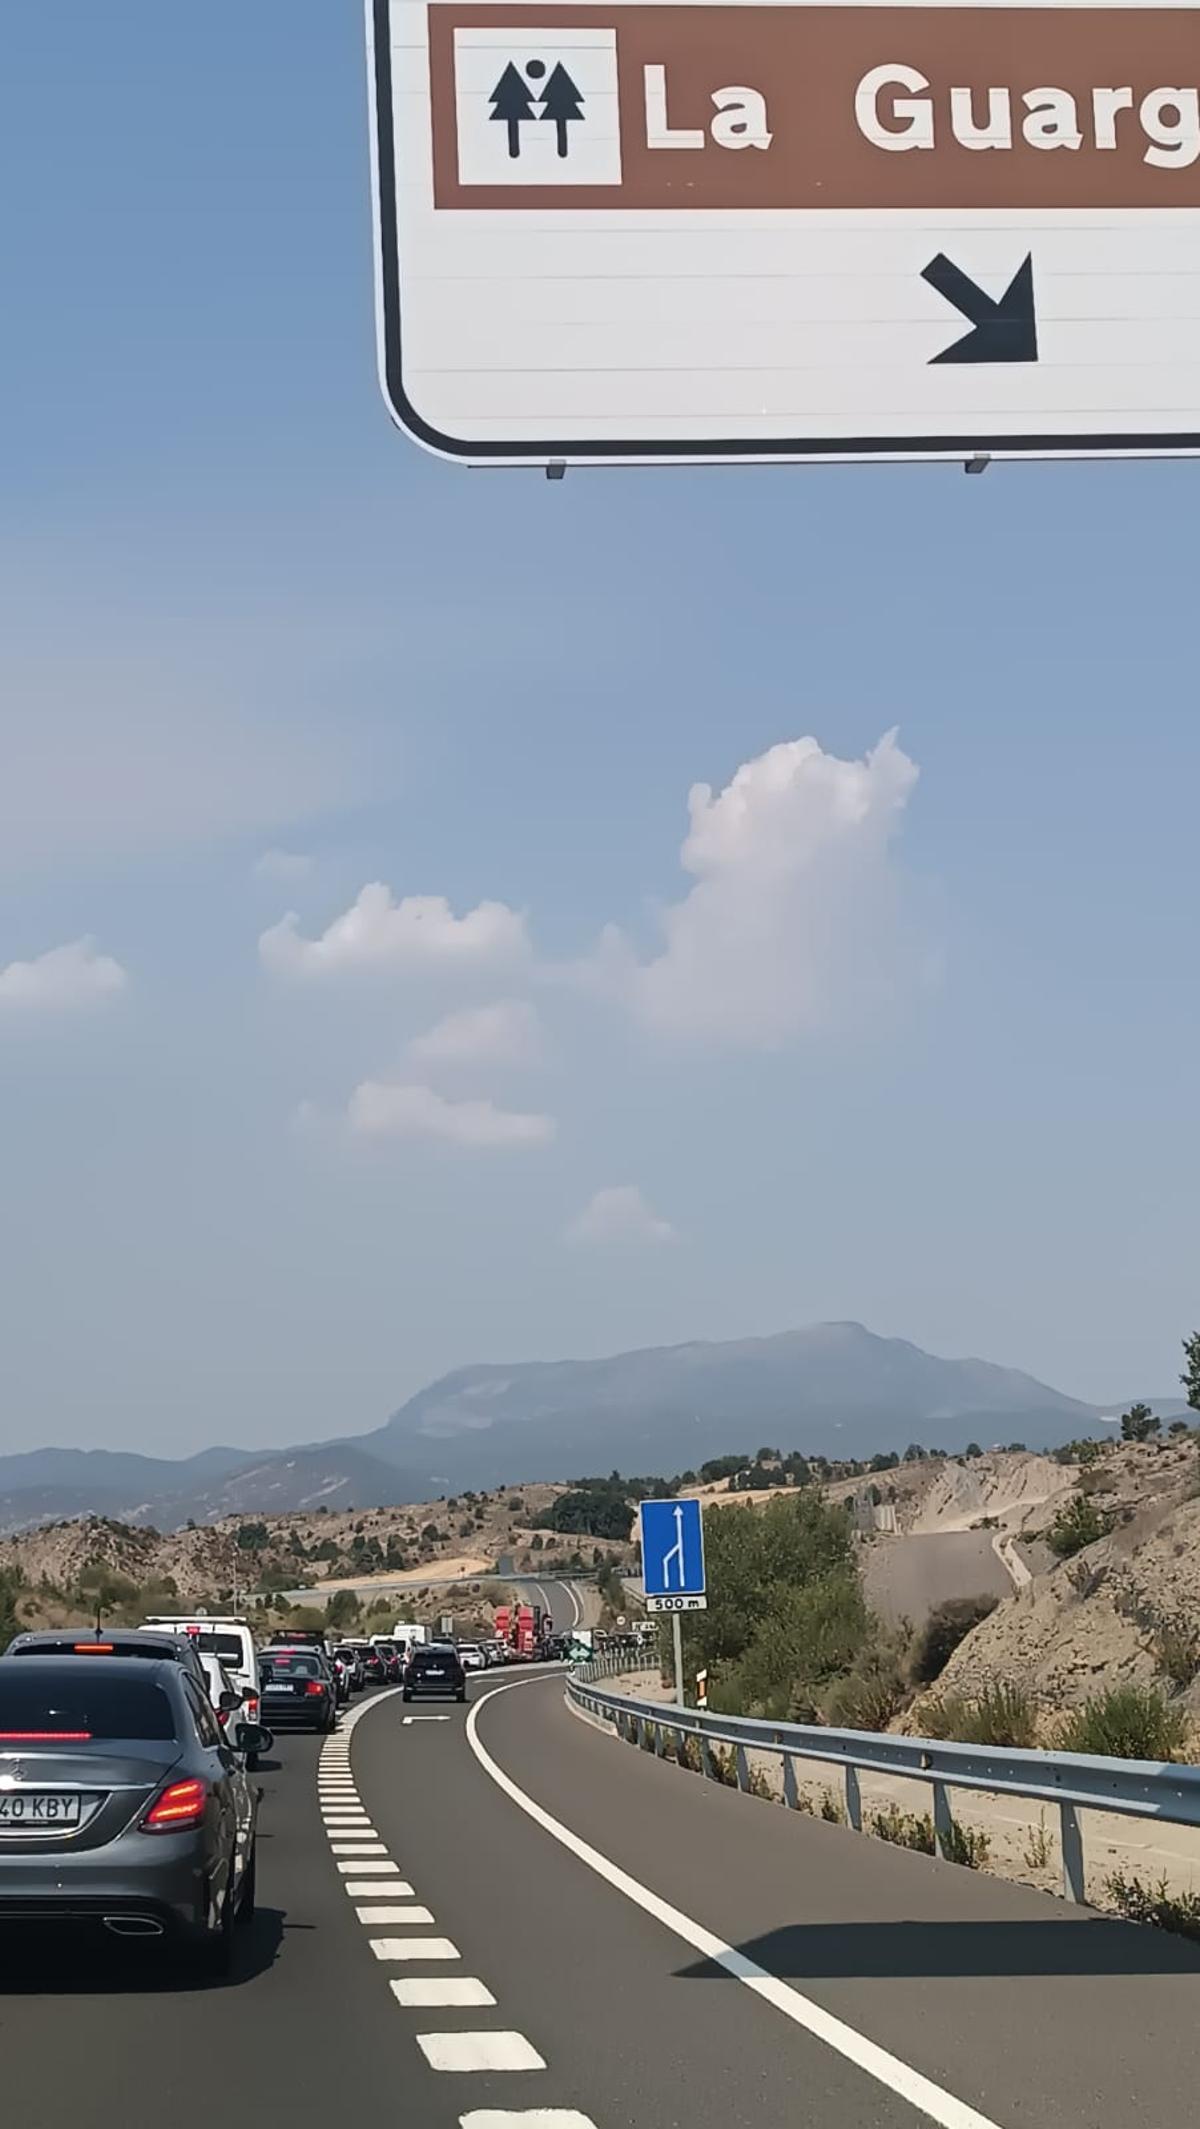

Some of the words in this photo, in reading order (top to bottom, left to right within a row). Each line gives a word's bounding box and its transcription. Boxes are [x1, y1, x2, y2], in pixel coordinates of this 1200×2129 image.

[643, 64, 773, 151] La
[854, 63, 1200, 169] Guarg
[655, 1598, 684, 1610] 500
[688, 1599, 699, 1608] m
[32, 1798, 73, 1817] KBY
